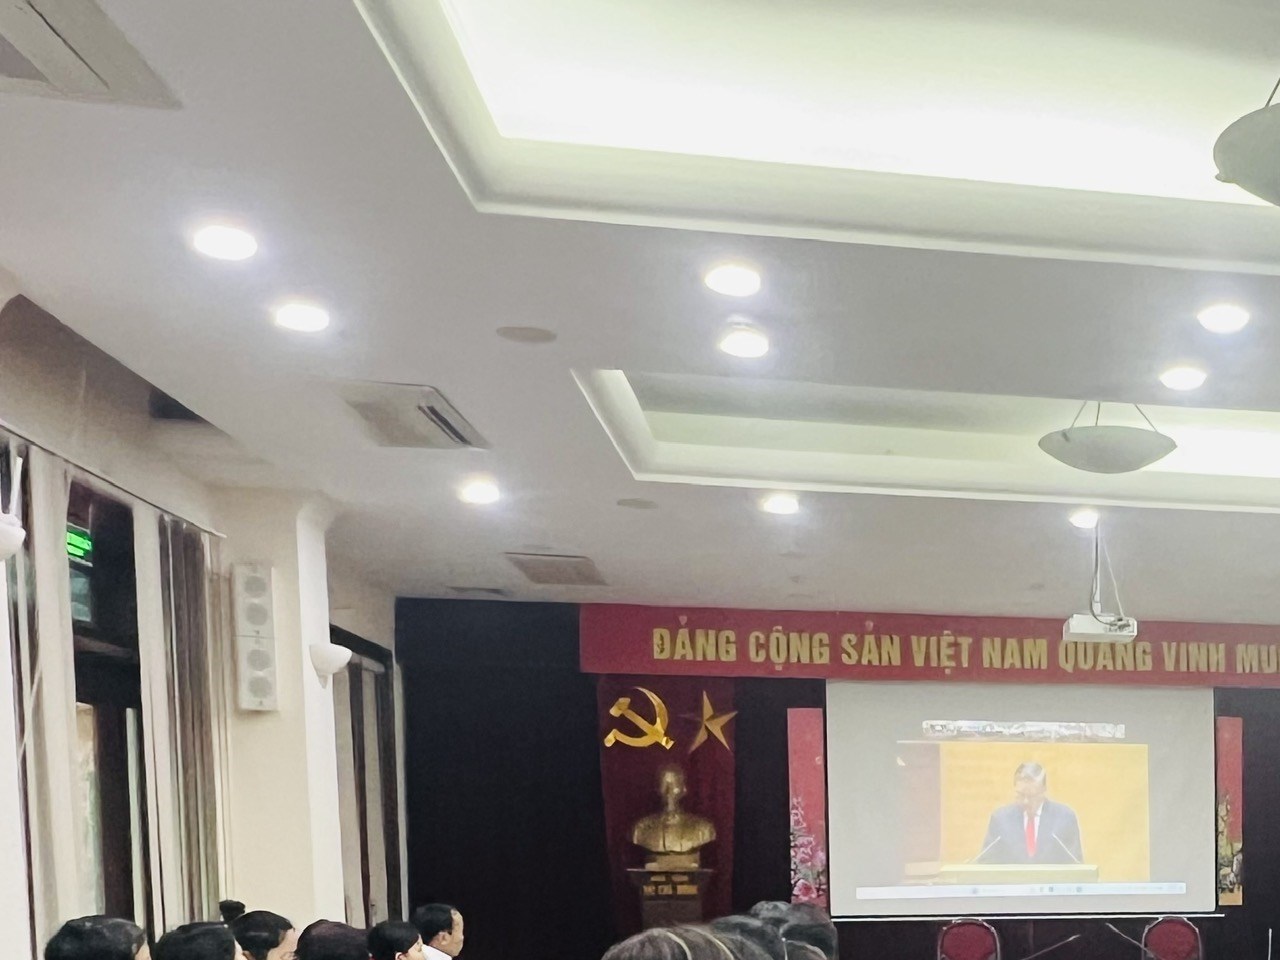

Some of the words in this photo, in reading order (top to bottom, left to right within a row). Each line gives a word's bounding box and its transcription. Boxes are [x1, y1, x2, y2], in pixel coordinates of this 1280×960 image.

[653, 615, 737, 662] ĐẢNG
[749, 626, 830, 671] CỘNG
[841, 620, 901, 666] SẢN
[911, 630, 973, 674] VIỆT
[982, 637, 1048, 670] NAM
[1058, 639, 1153, 673] QUANG
[1162, 641, 1226, 673] VINH
